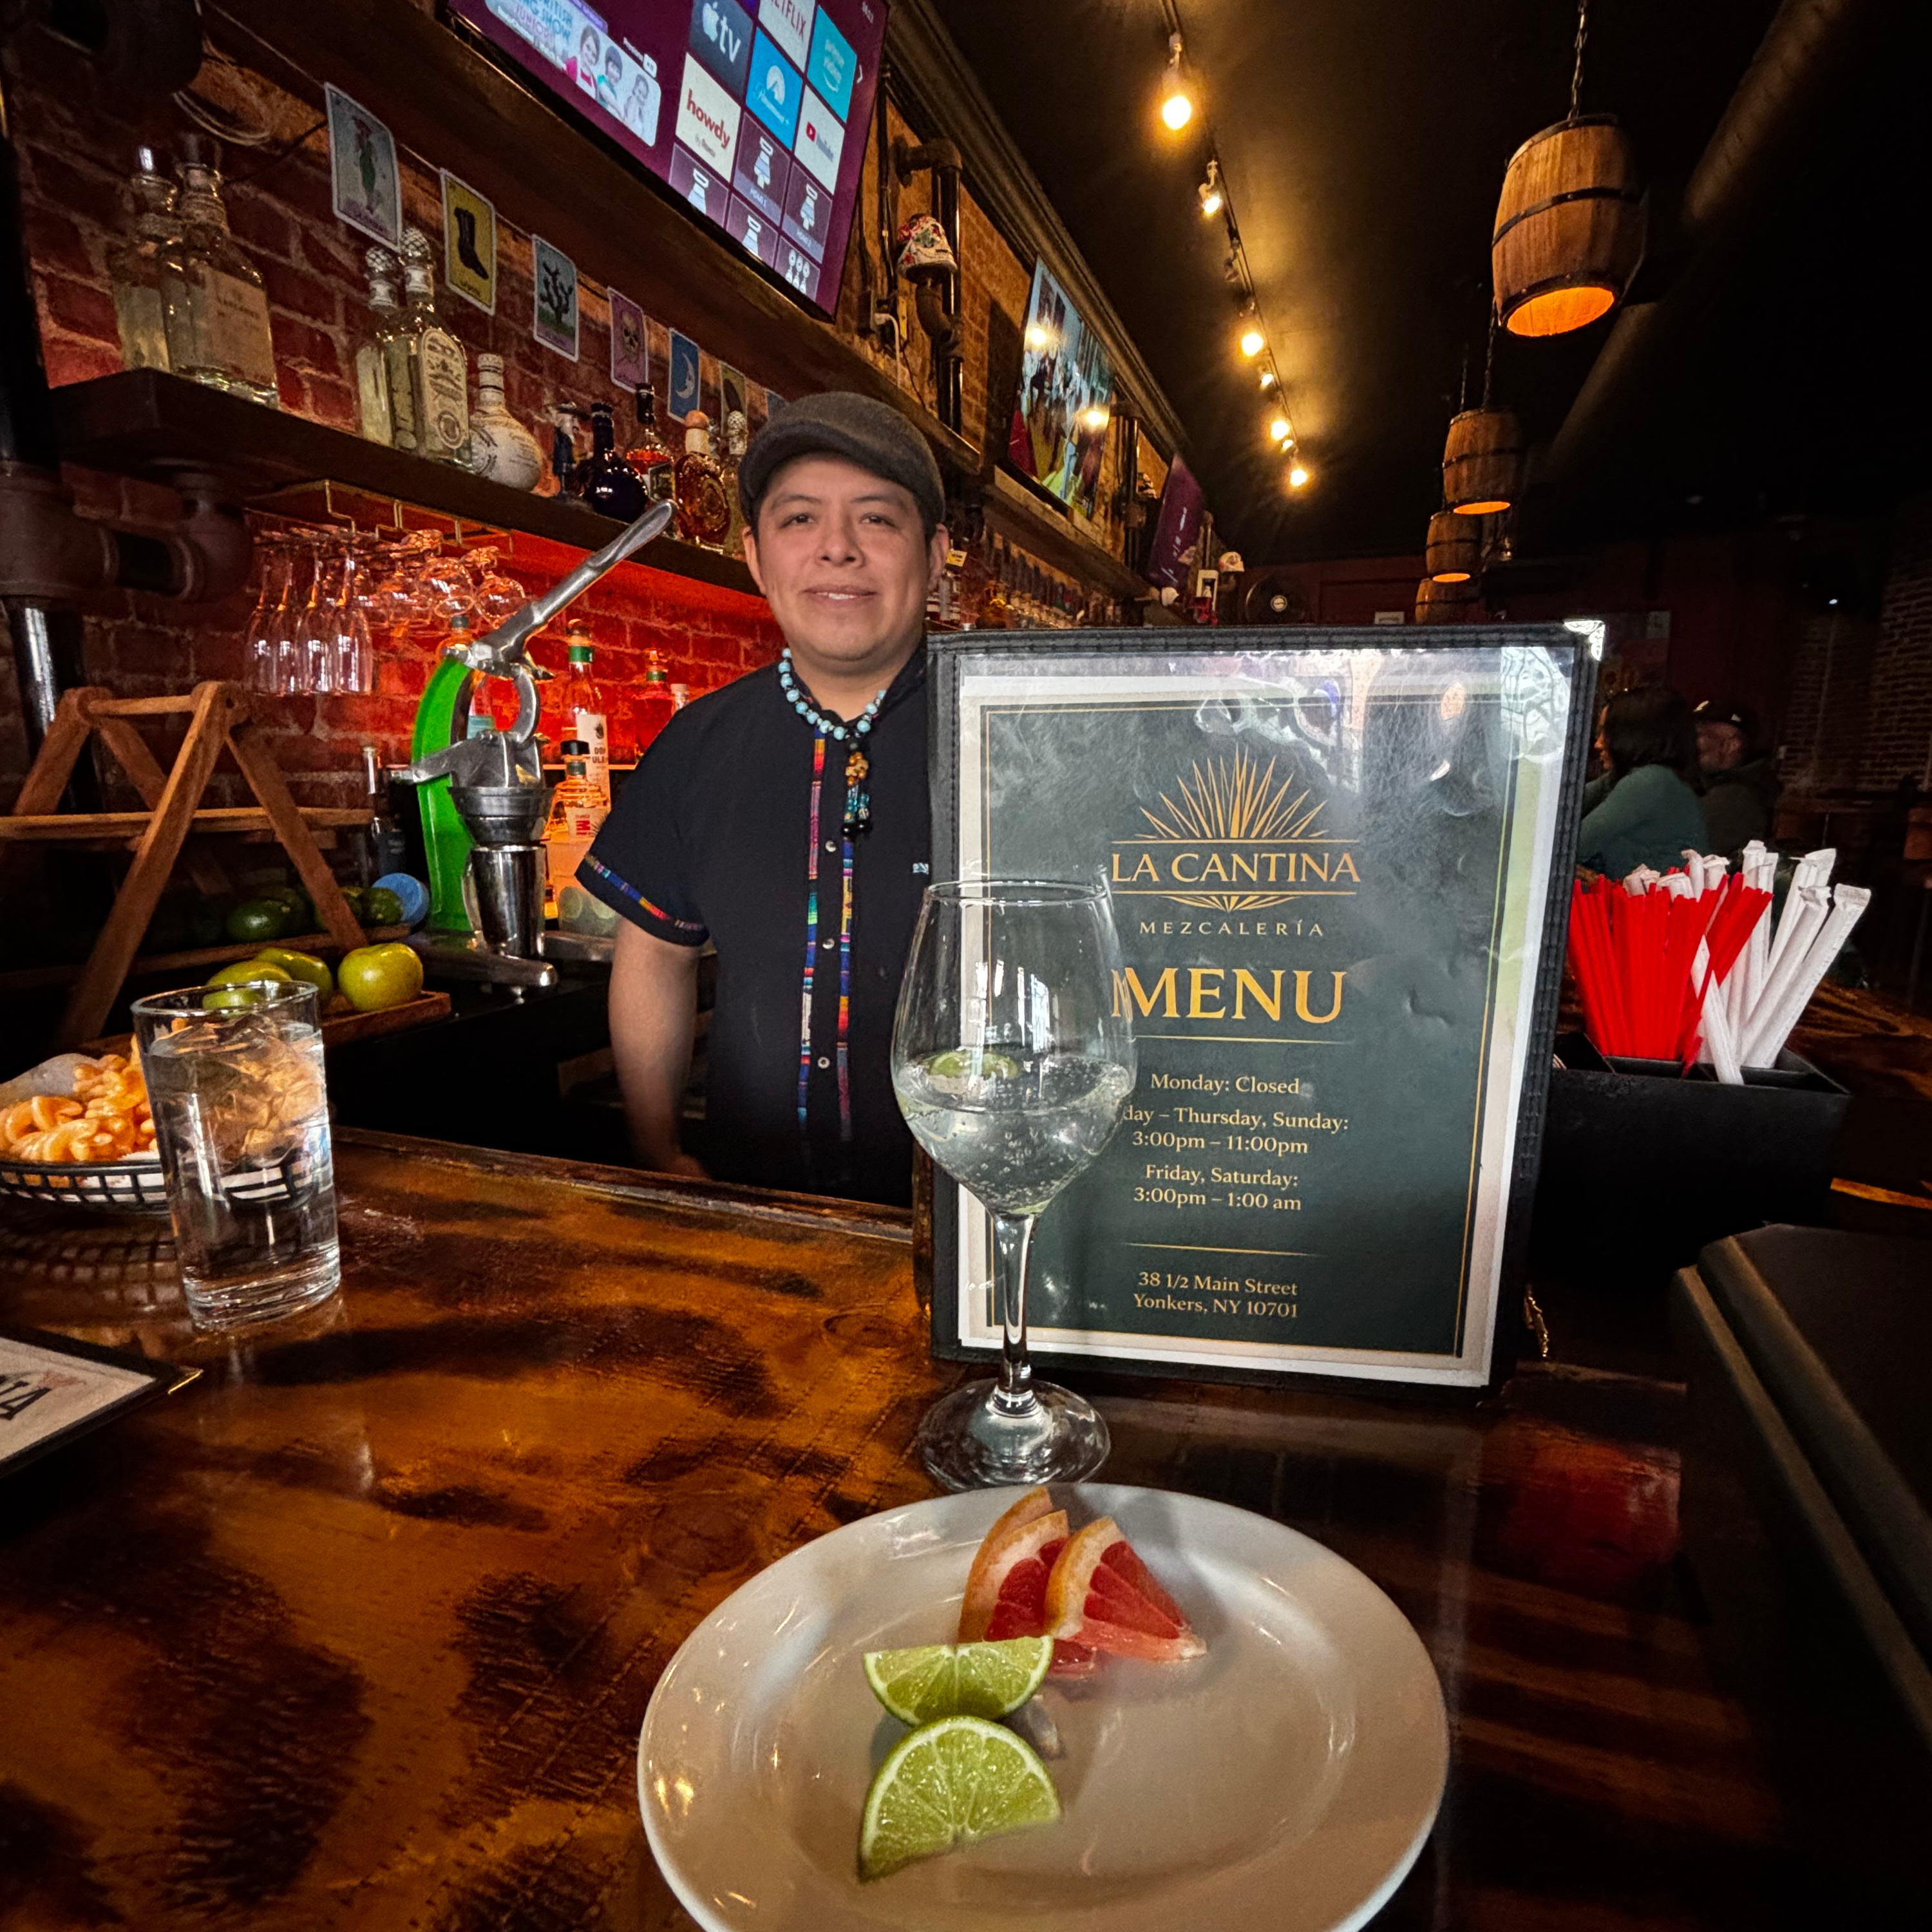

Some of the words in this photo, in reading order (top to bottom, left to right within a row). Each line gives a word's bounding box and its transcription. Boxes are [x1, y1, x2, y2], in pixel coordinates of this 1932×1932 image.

[686, 88, 730, 149] howdy
[1112, 853, 1160, 882] LA
[1171, 853, 1361, 882] CANTINA
[1139, 918, 1323, 936] MEZCALERÍA
[1111, 967, 1347, 1023] MENU
[1151, 1074, 1229, 1095] Monday:
[1235, 1076, 1300, 1094] Closed
[1173, 1106, 1266, 1130] Thursday,
[1273, 1112, 1349, 1134] Sunday:
[1132, 1131, 1205, 1153] 3:00pm
[1227, 1135, 1309, 1157] 11:00pm
[1146, 1164, 1205, 1186] Friday,
[1211, 1168, 1298, 1191] Saturday:
[1133, 1187, 1206, 1209] 3:00pm
[1227, 1192, 1268, 1209] 1:00
[1273, 1197, 1302, 1211] am
[1138, 1271, 1160, 1287] 38
[1166, 1273, 1189, 1289] 1/2
[1193, 1275, 1239, 1292] Main
[1245, 1278, 1298, 1296] Street
[1133, 1293, 1208, 1314] Yonkers,
[1213, 1298, 1242, 1314] NY
[1247, 1300, 1298, 1318] 10701
